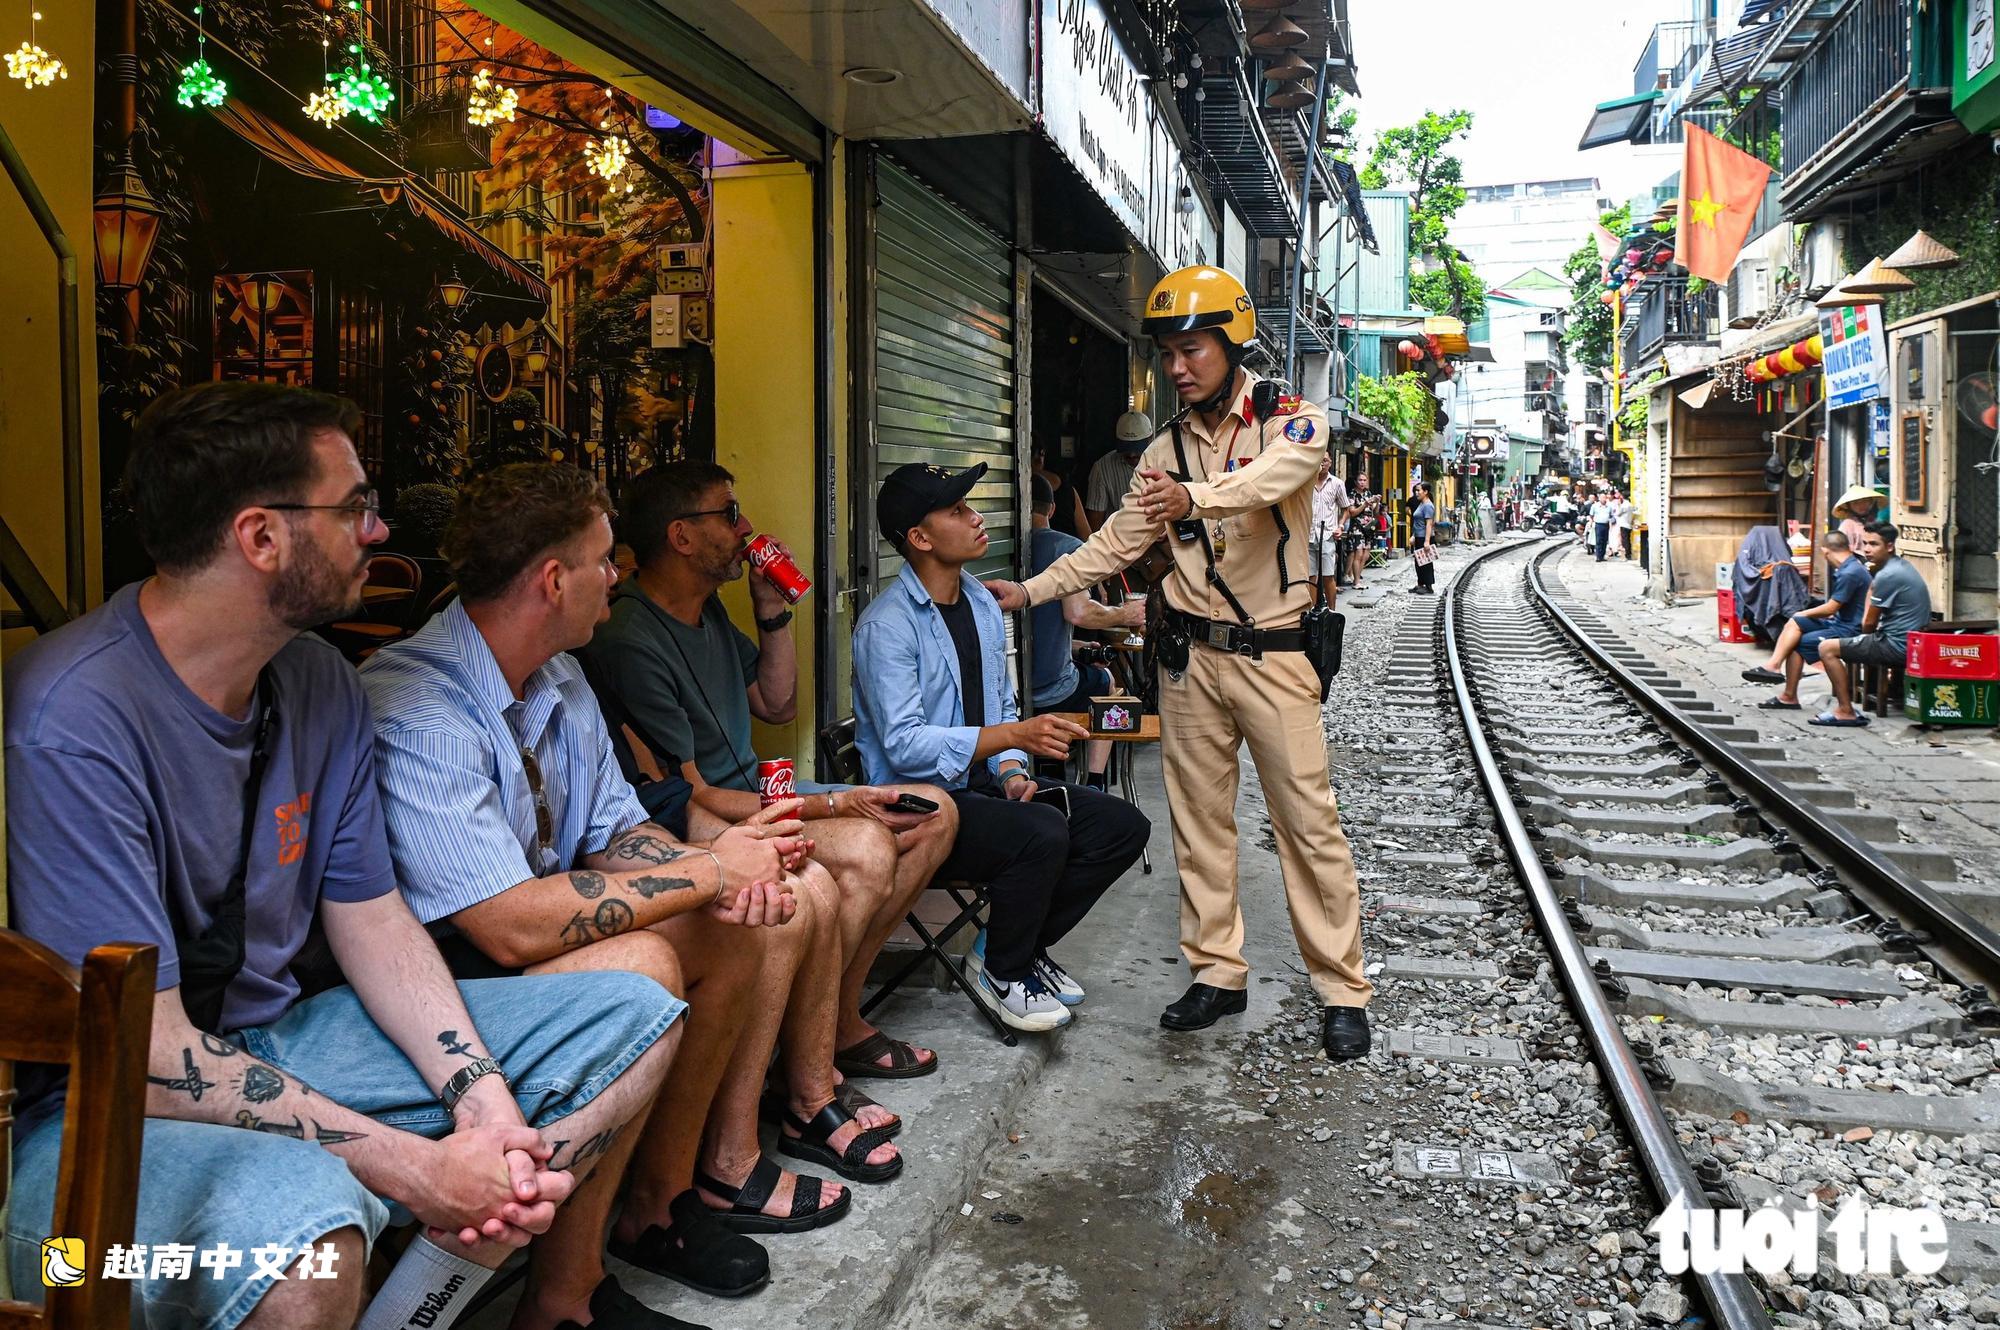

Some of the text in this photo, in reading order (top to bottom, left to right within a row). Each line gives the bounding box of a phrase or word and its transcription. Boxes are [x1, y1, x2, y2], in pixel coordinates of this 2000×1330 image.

[1851, 336, 1873, 368] OFFICE
[1939, 646, 1980, 658] HANOI BEER
[1929, 709, 1962, 718] SAIGON
[408, 1274, 466, 1329] Wilson
